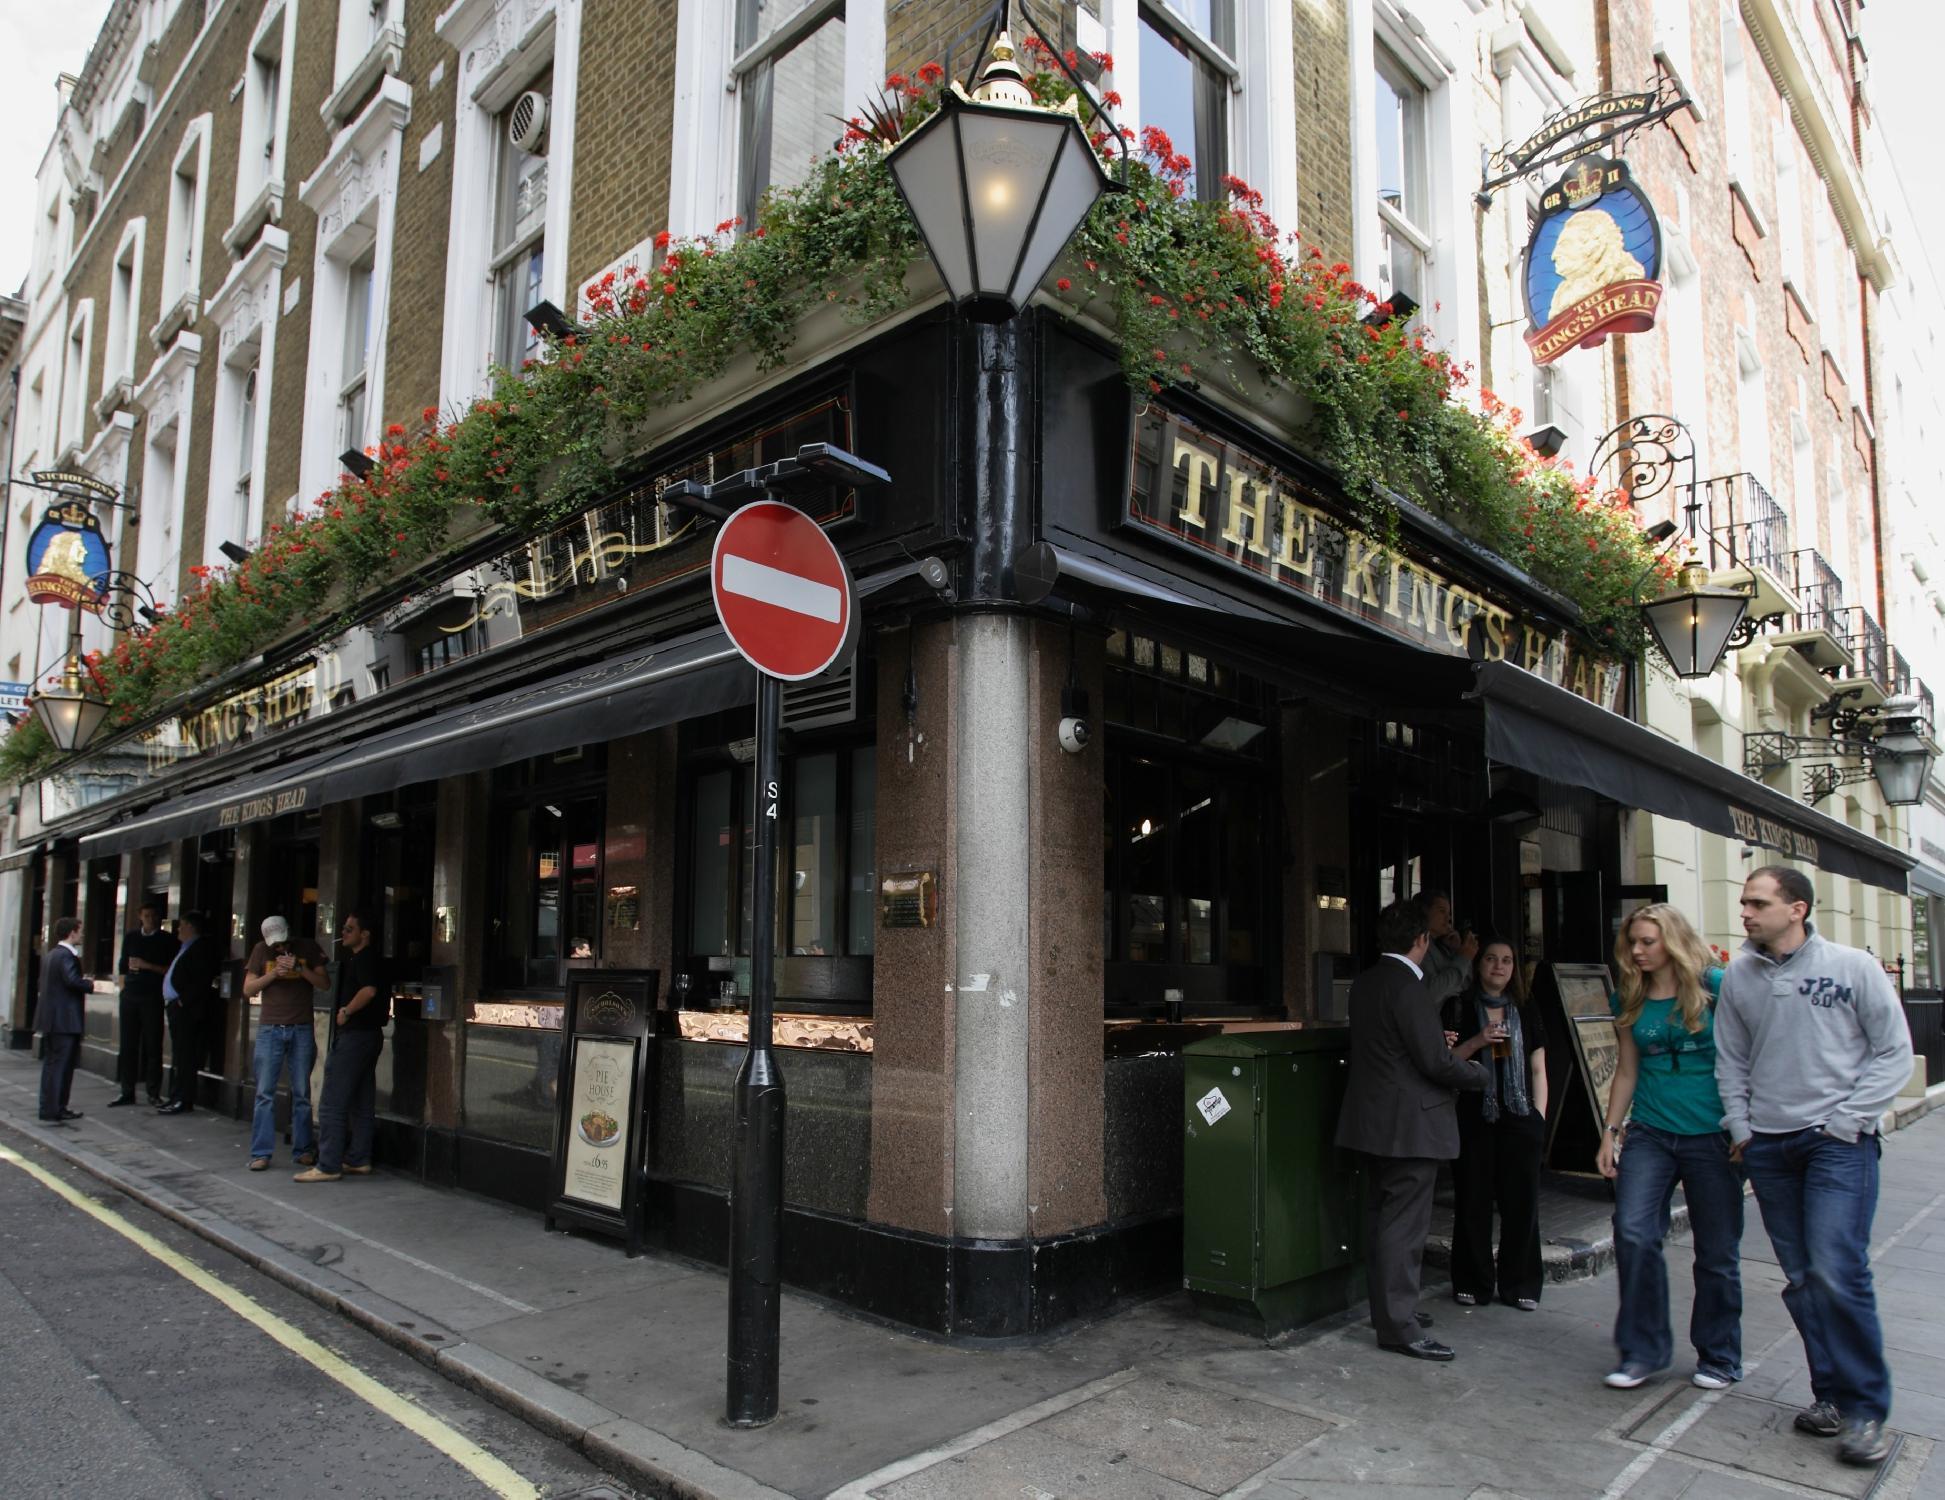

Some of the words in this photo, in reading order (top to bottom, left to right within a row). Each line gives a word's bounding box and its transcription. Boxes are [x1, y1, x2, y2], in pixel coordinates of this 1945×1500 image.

[1516, 97, 1646, 160] NICHOLSON'S
[1573, 290, 1607, 314] THE
[1532, 311, 1596, 358] KING'S
[1595, 290, 1660, 320] HEAD
[1172, 436, 1316, 578] THE
[1342, 530, 1508, 662] KING'S
[767, 781, 778, 799] S
[219, 805, 240, 827] THE
[241, 793, 274, 822] KING'S
[274, 787, 307, 814] HEAD
[766, 802, 778, 820] 4
[1728, 805, 1758, 841] THE
[588, 1083, 614, 1098] HOUSE
[596, 1069, 609, 1085] PIE
